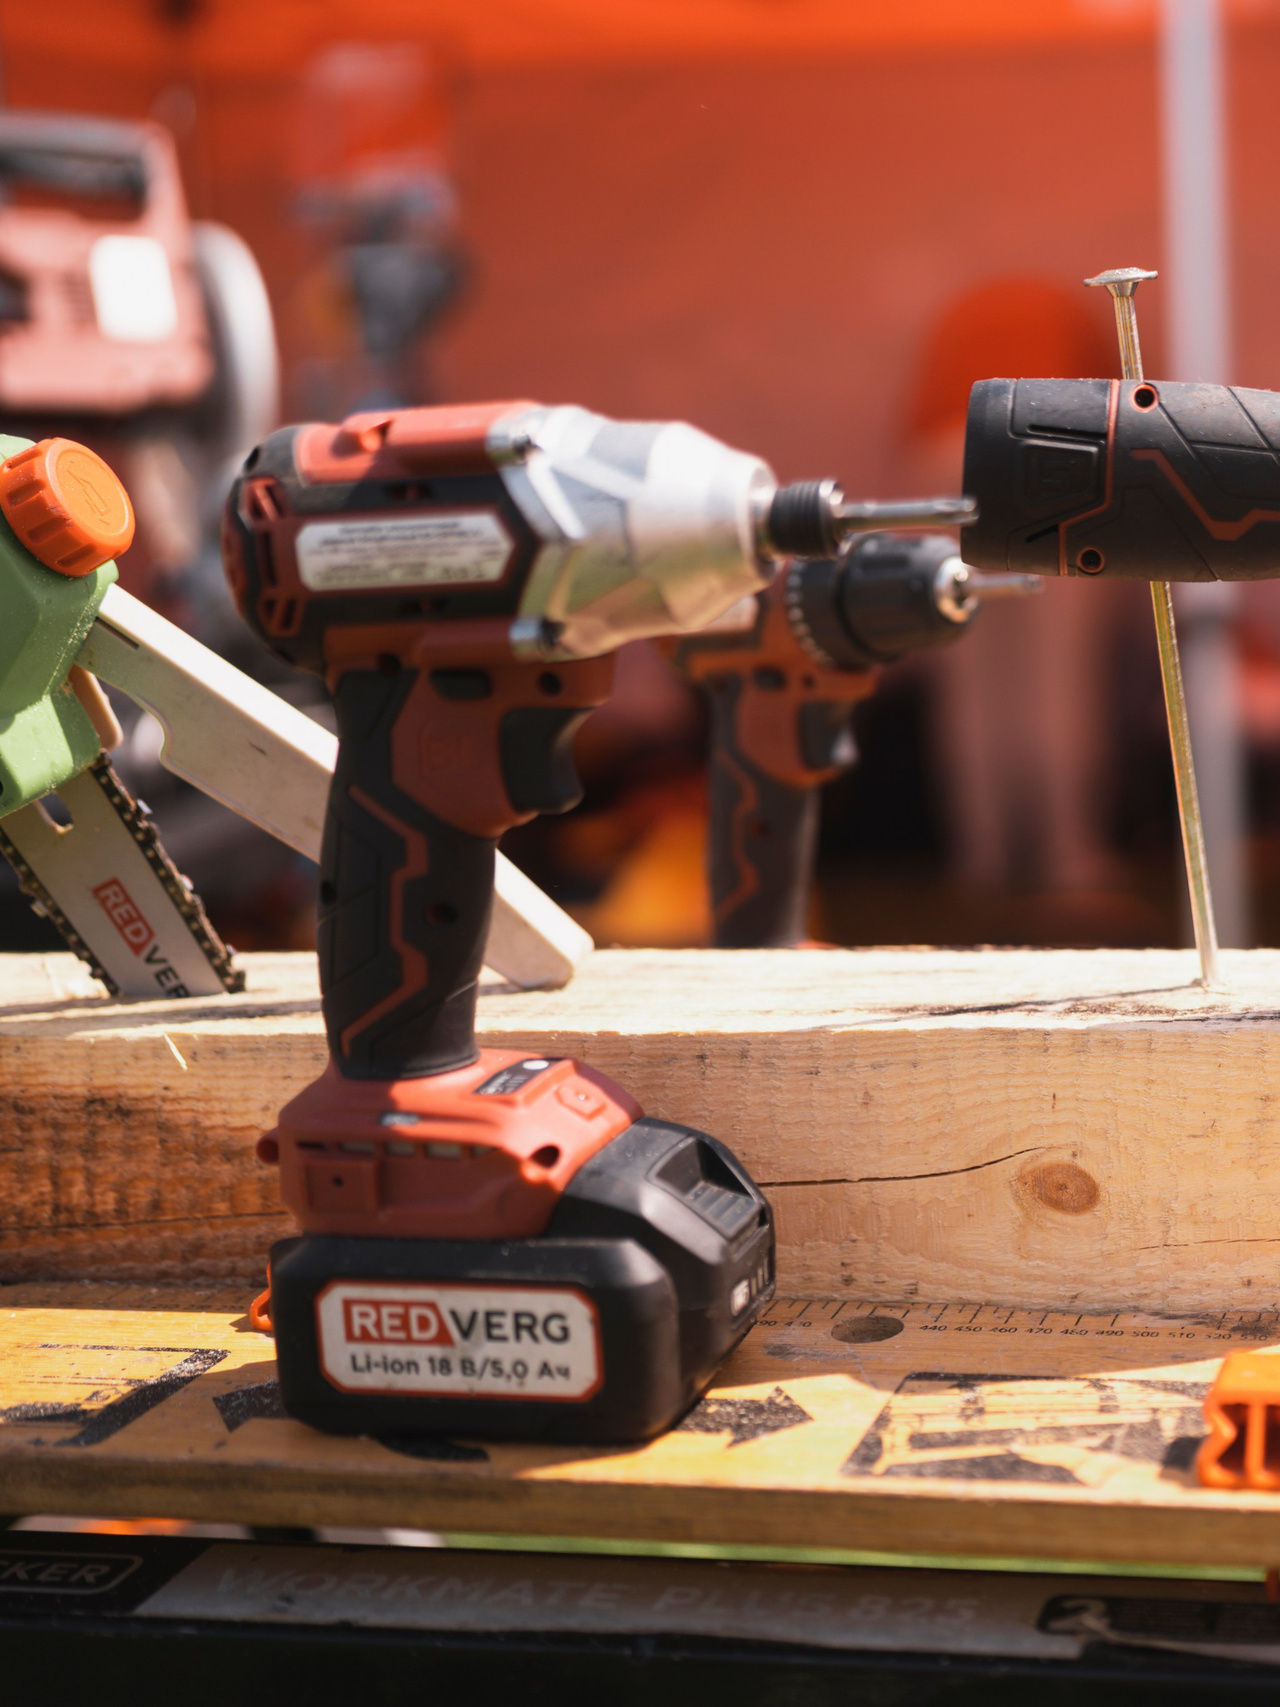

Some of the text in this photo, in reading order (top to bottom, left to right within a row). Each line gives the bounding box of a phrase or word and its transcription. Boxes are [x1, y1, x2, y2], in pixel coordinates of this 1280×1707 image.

[93, 877, 191, 997] REDVER
[349, 1303, 571, 1345] REDVERG
[428, 1356, 453, 1377] 18
[216, 1566, 635, 1611] WORKMATE
